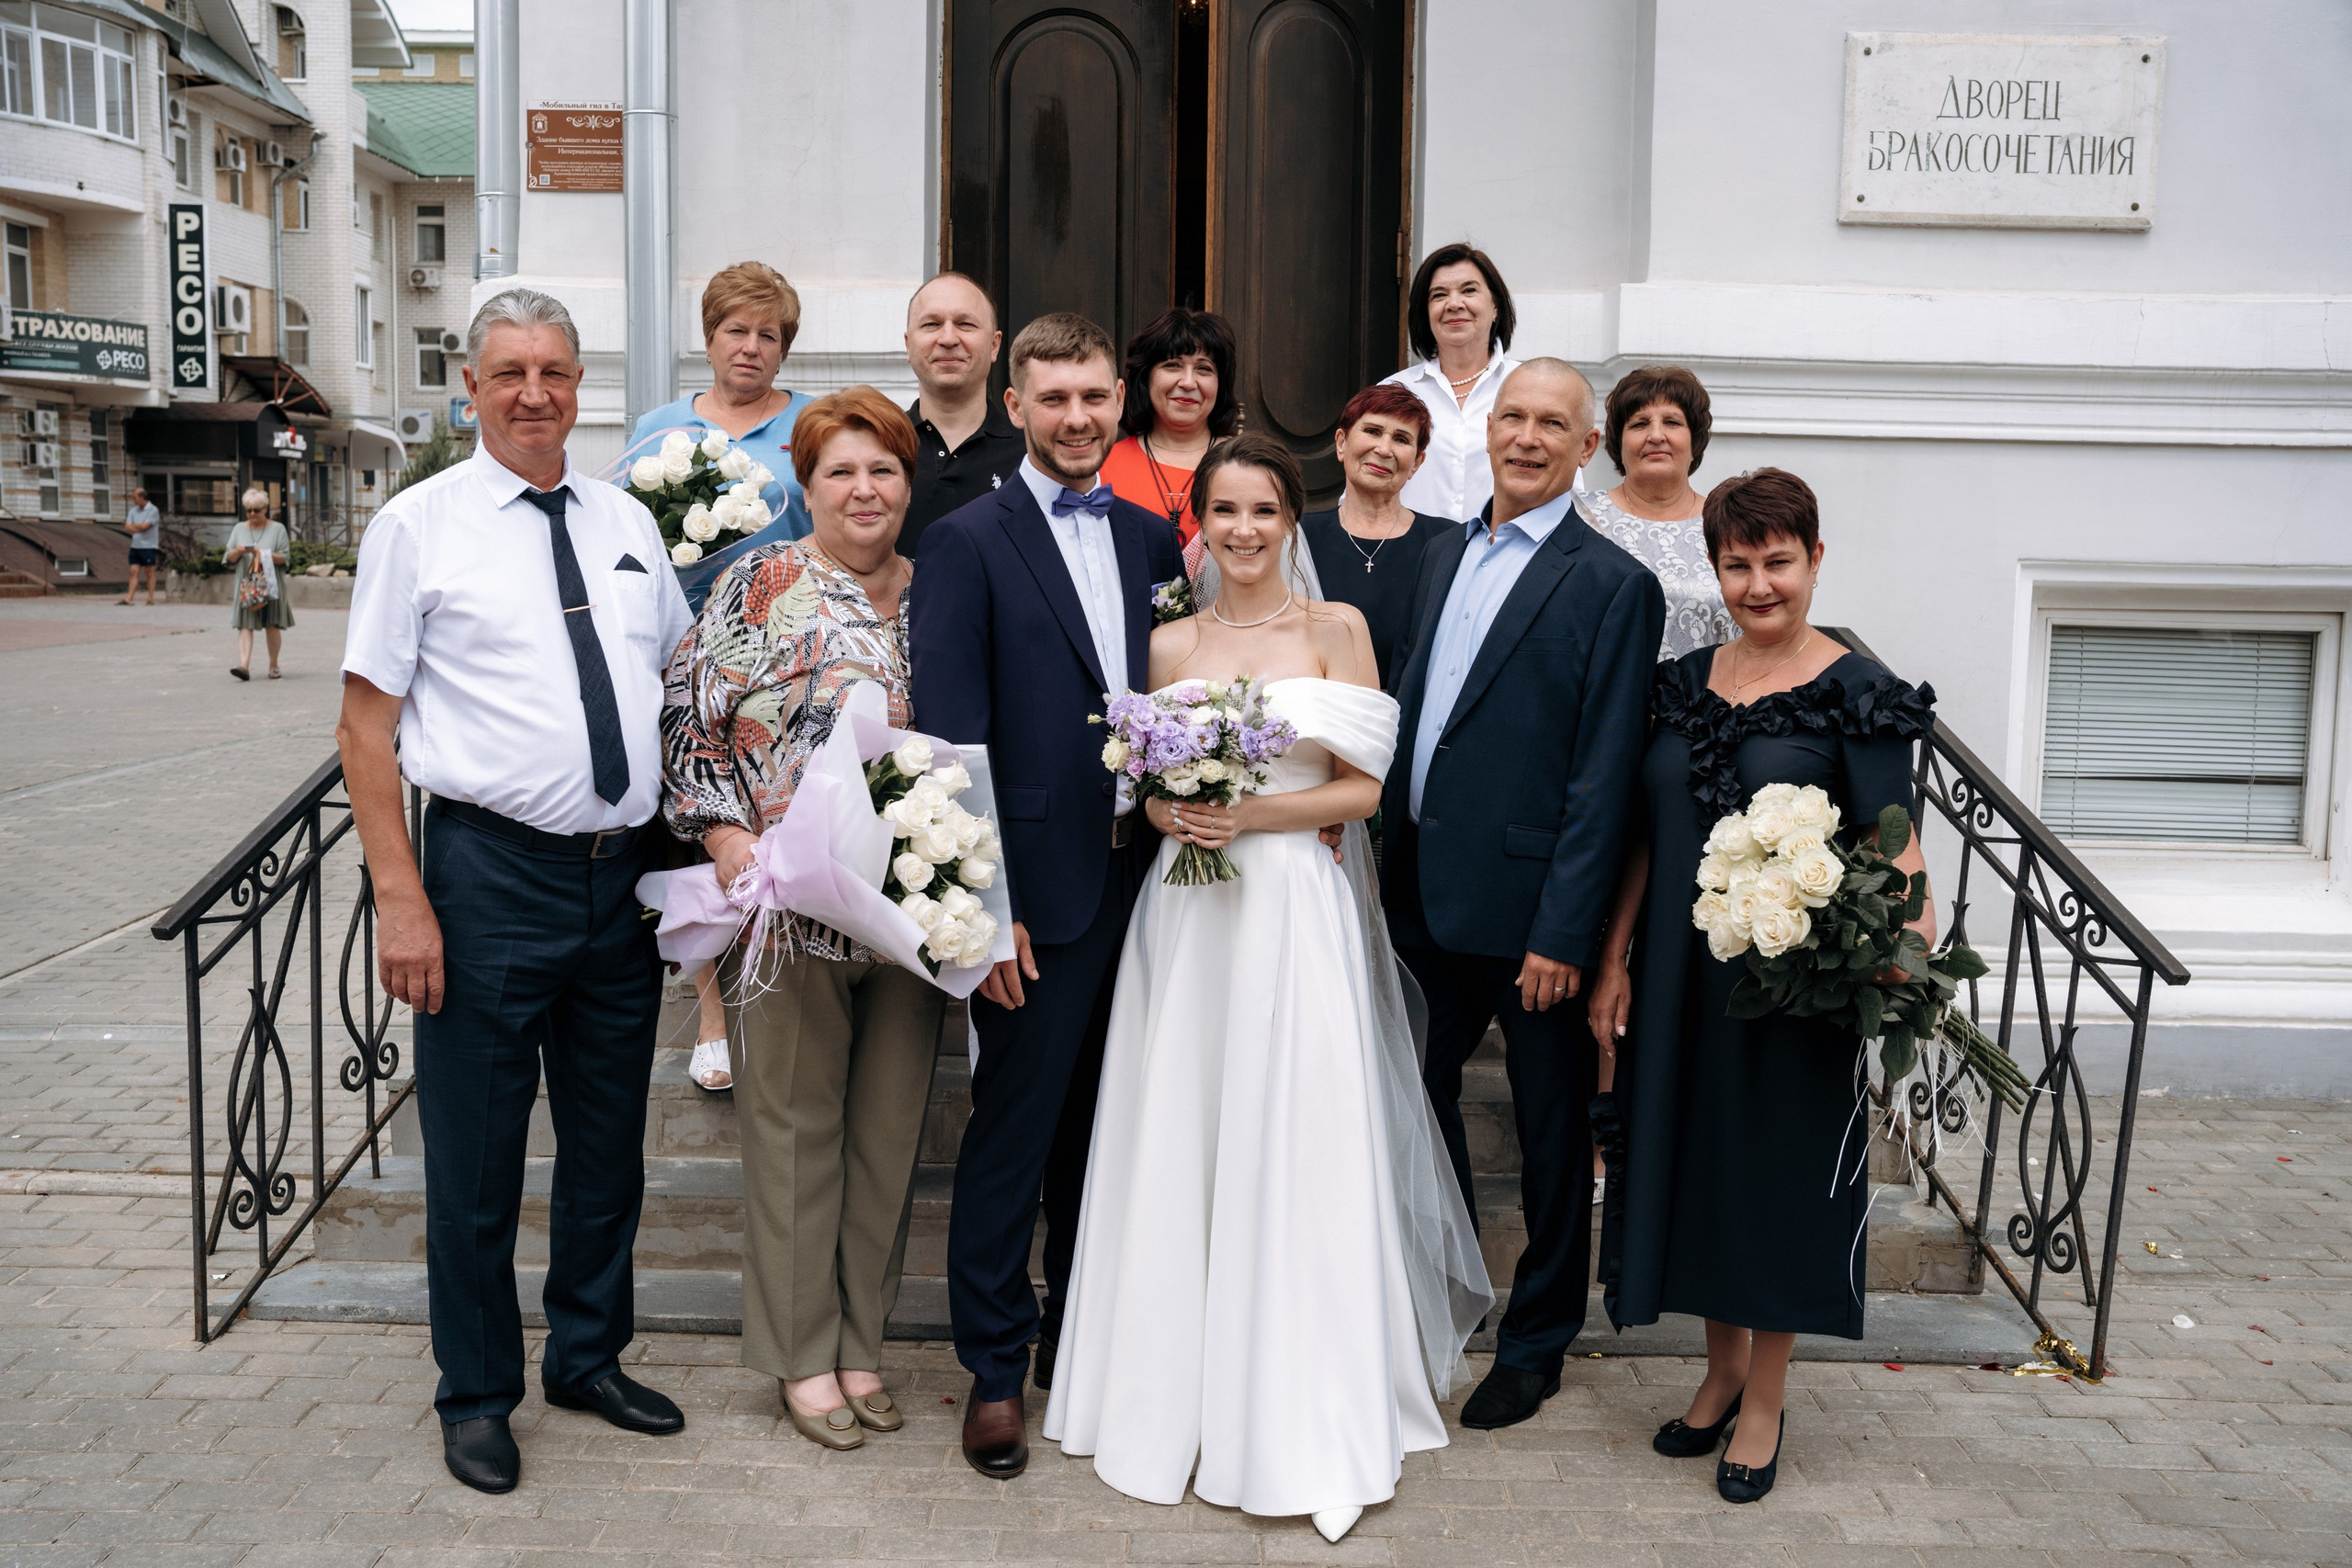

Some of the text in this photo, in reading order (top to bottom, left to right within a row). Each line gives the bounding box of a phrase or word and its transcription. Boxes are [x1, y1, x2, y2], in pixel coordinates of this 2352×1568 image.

[1936, 74, 2061, 121] ДВОРЕЦ
[1867, 130, 2135, 175] БРАКОСОЧЕТАНИЯ
[175, 210, 204, 336] РЕСО
[112, 349, 145, 370] РЕСО
